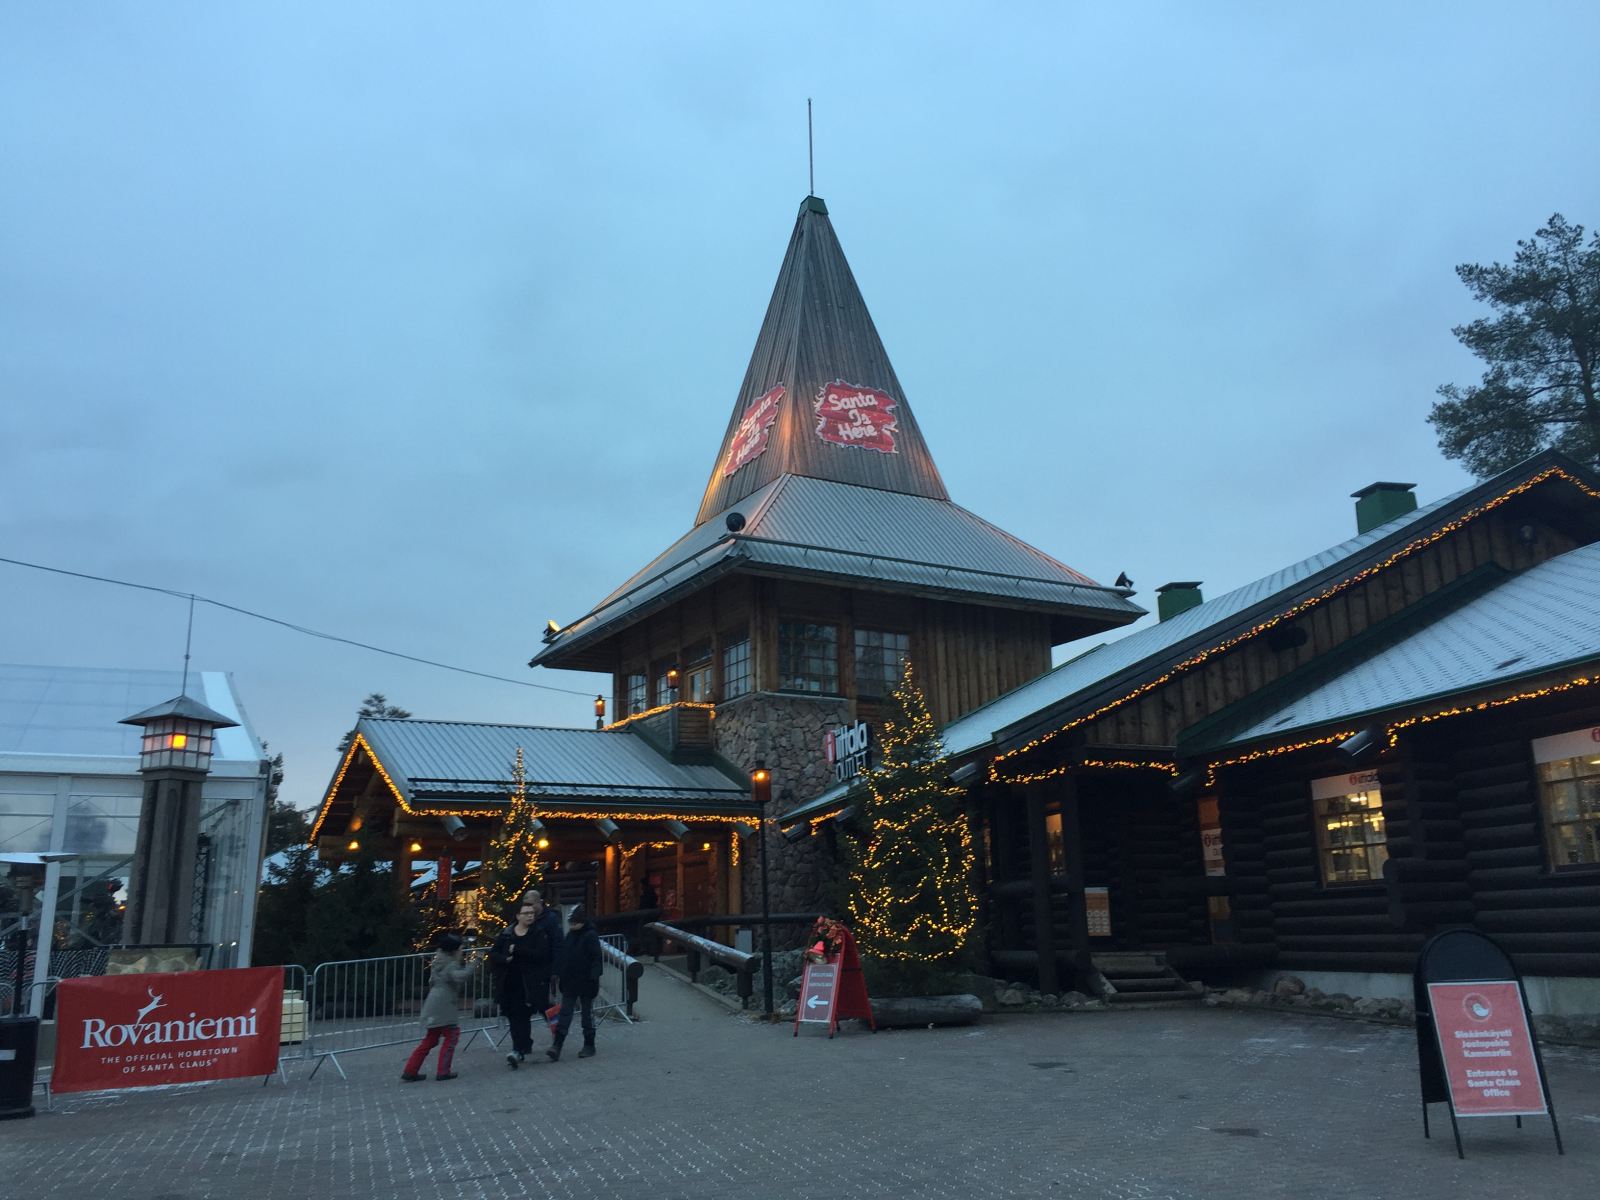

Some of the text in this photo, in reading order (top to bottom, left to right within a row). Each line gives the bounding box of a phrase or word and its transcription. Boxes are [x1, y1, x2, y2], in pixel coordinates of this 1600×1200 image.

[828, 392, 879, 411] Santa
[737, 395, 772, 440] Santa
[848, 408, 872, 427] Is
[837, 423, 878, 441] Here
[80, 1008, 259, 1049] Rovaniemi
[125, 1052, 173, 1063] OFFICIAL
[177, 1046, 238, 1058] HOMETOWN
[122, 1066, 136, 1074] OF
[140, 1063, 174, 1072] SANTA
